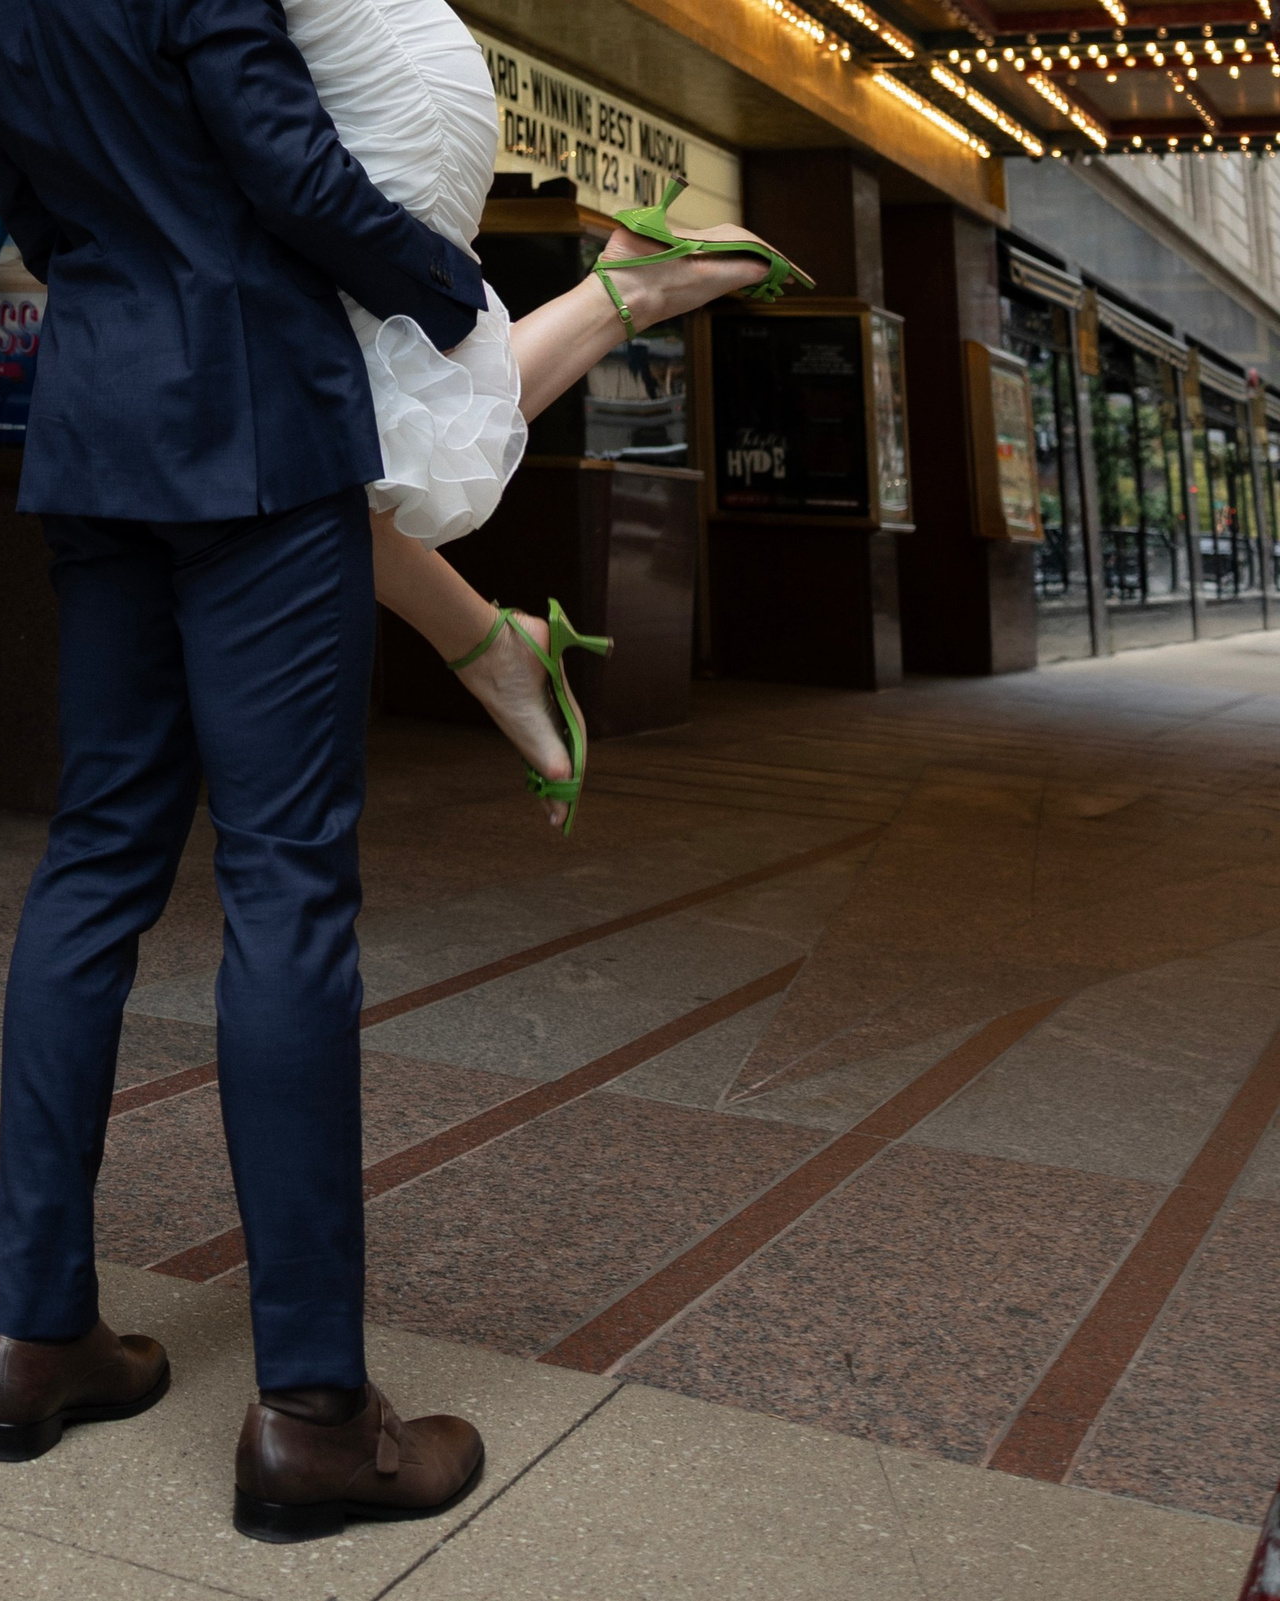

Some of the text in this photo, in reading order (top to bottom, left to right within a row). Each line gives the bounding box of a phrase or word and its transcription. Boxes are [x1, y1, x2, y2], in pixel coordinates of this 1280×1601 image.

[504, 108, 568, 173] DEMAND
[575, 140, 598, 187] OCT
[601, 152, 619, 196] 23
[633, 162, 657, 208] NOV
[598, 102, 633, 154] BEST
[638, 119, 687, 179] MUSICAL
[727, 446, 787, 487] HYDE
